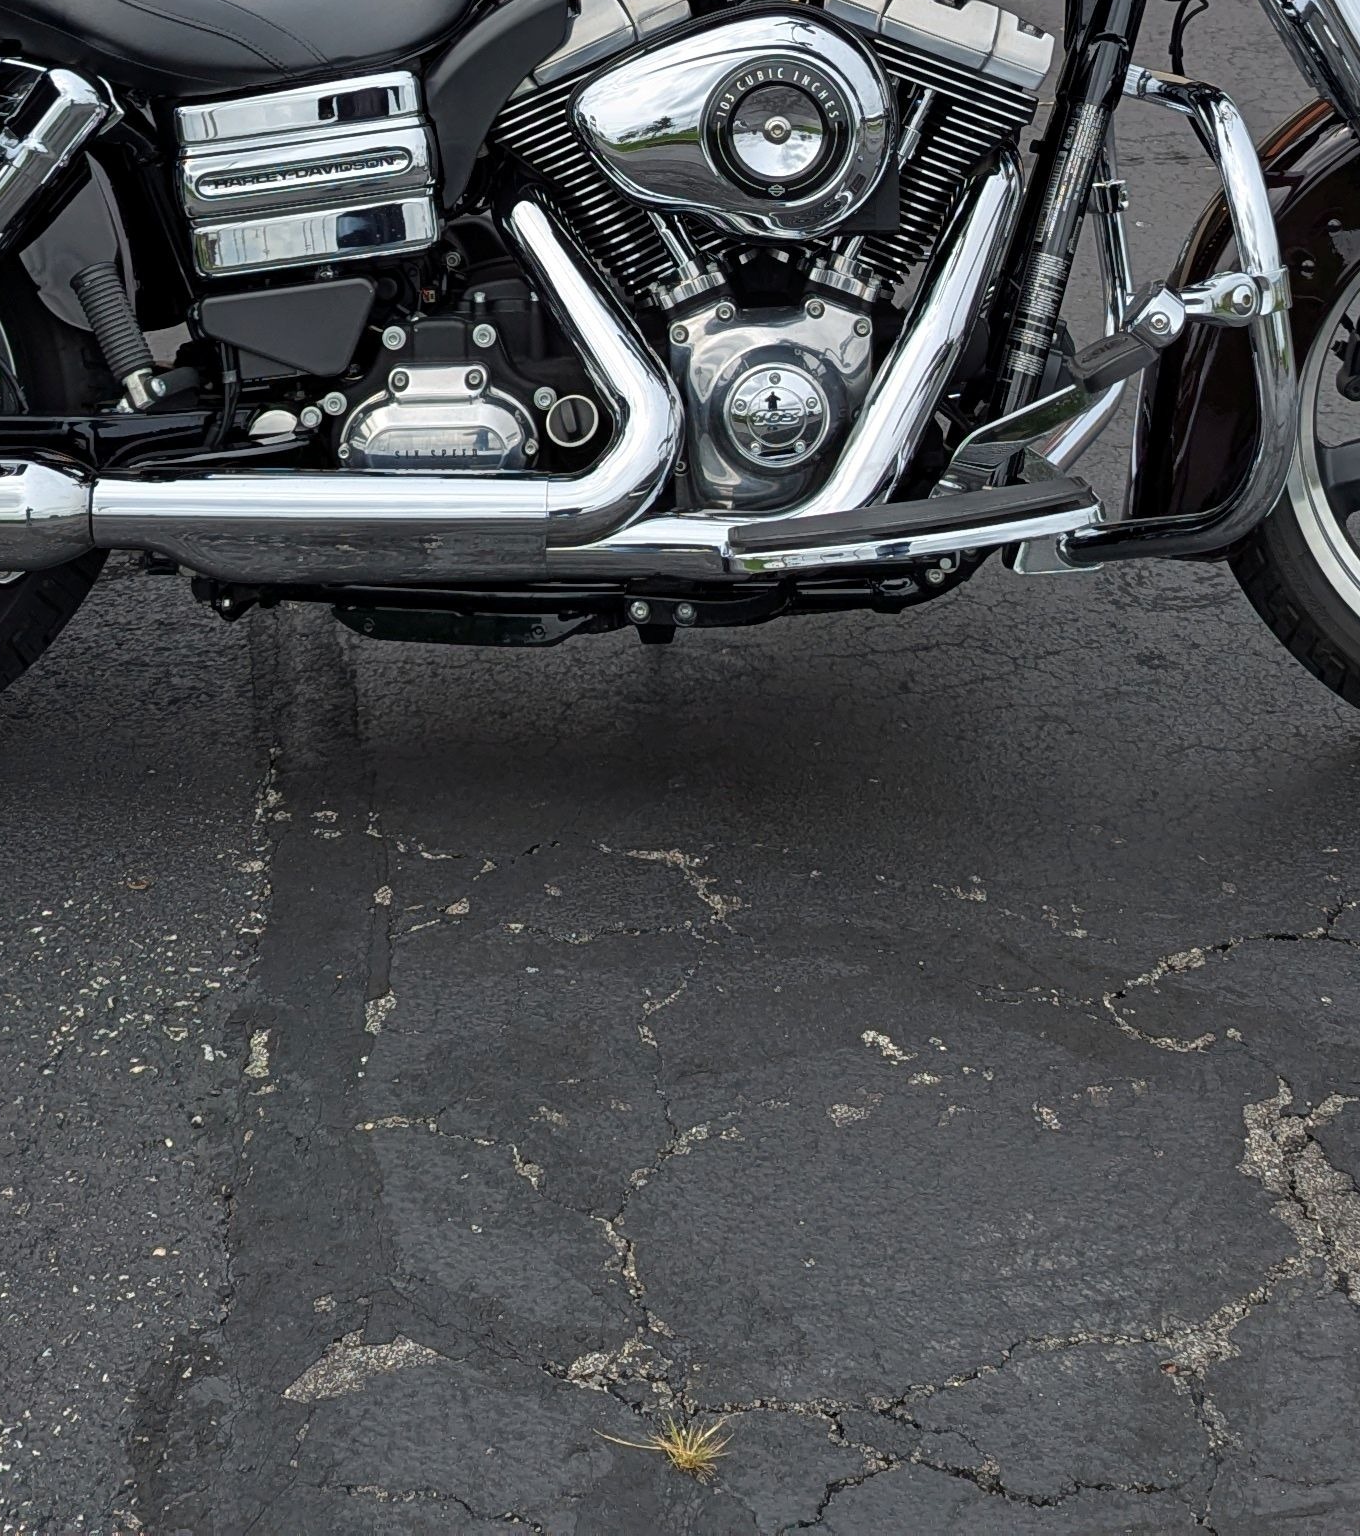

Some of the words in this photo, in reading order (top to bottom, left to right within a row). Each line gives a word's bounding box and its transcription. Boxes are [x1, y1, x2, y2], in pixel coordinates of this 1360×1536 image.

[717, 92, 735, 117] 103
[736, 68, 784, 91] CUBIC
[793, 71, 840, 119] INCHES
[213, 156, 400, 190] HARLEY-DAVIDSON
[394, 449, 420, 460] SIX
[430, 448, 479, 460] SPEED
